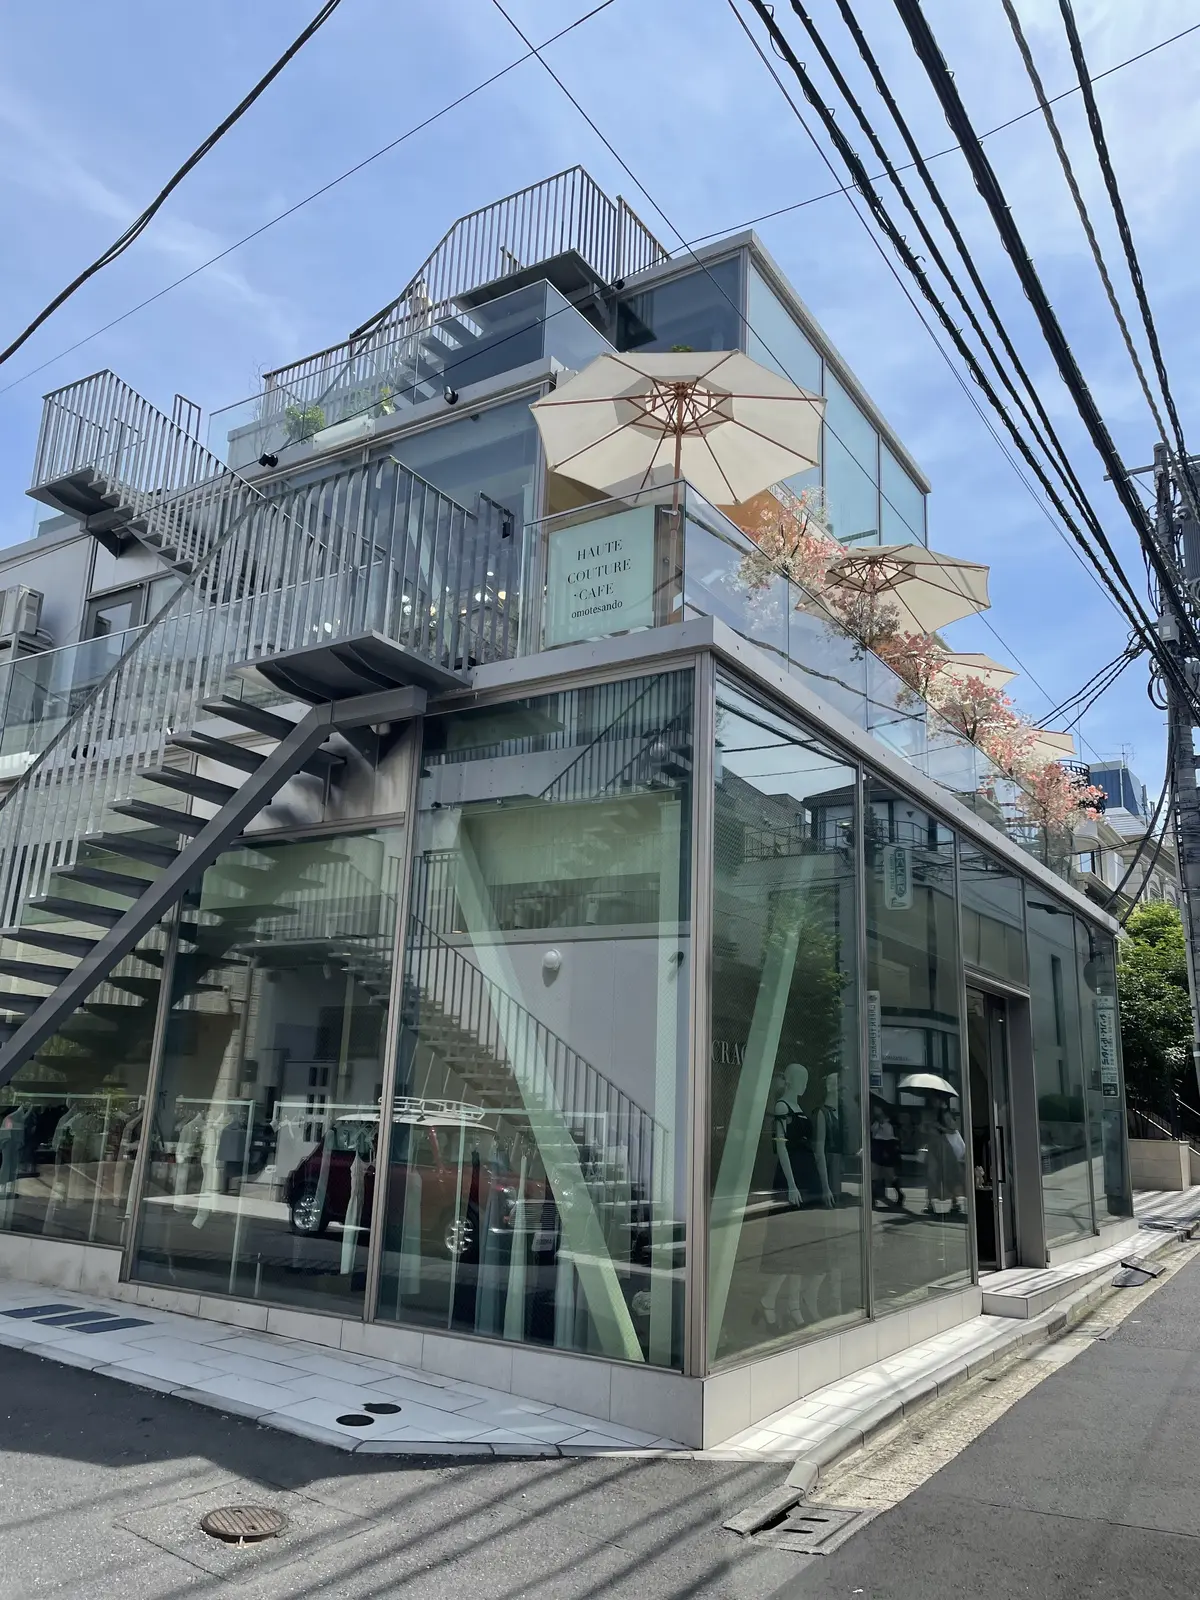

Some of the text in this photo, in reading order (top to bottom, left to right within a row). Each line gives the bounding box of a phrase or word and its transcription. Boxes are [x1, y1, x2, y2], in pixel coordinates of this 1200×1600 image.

[577, 539, 623, 561] HAUTE
[567, 558, 631, 585] COUTURE
[571, 599, 623, 619] omotesando
